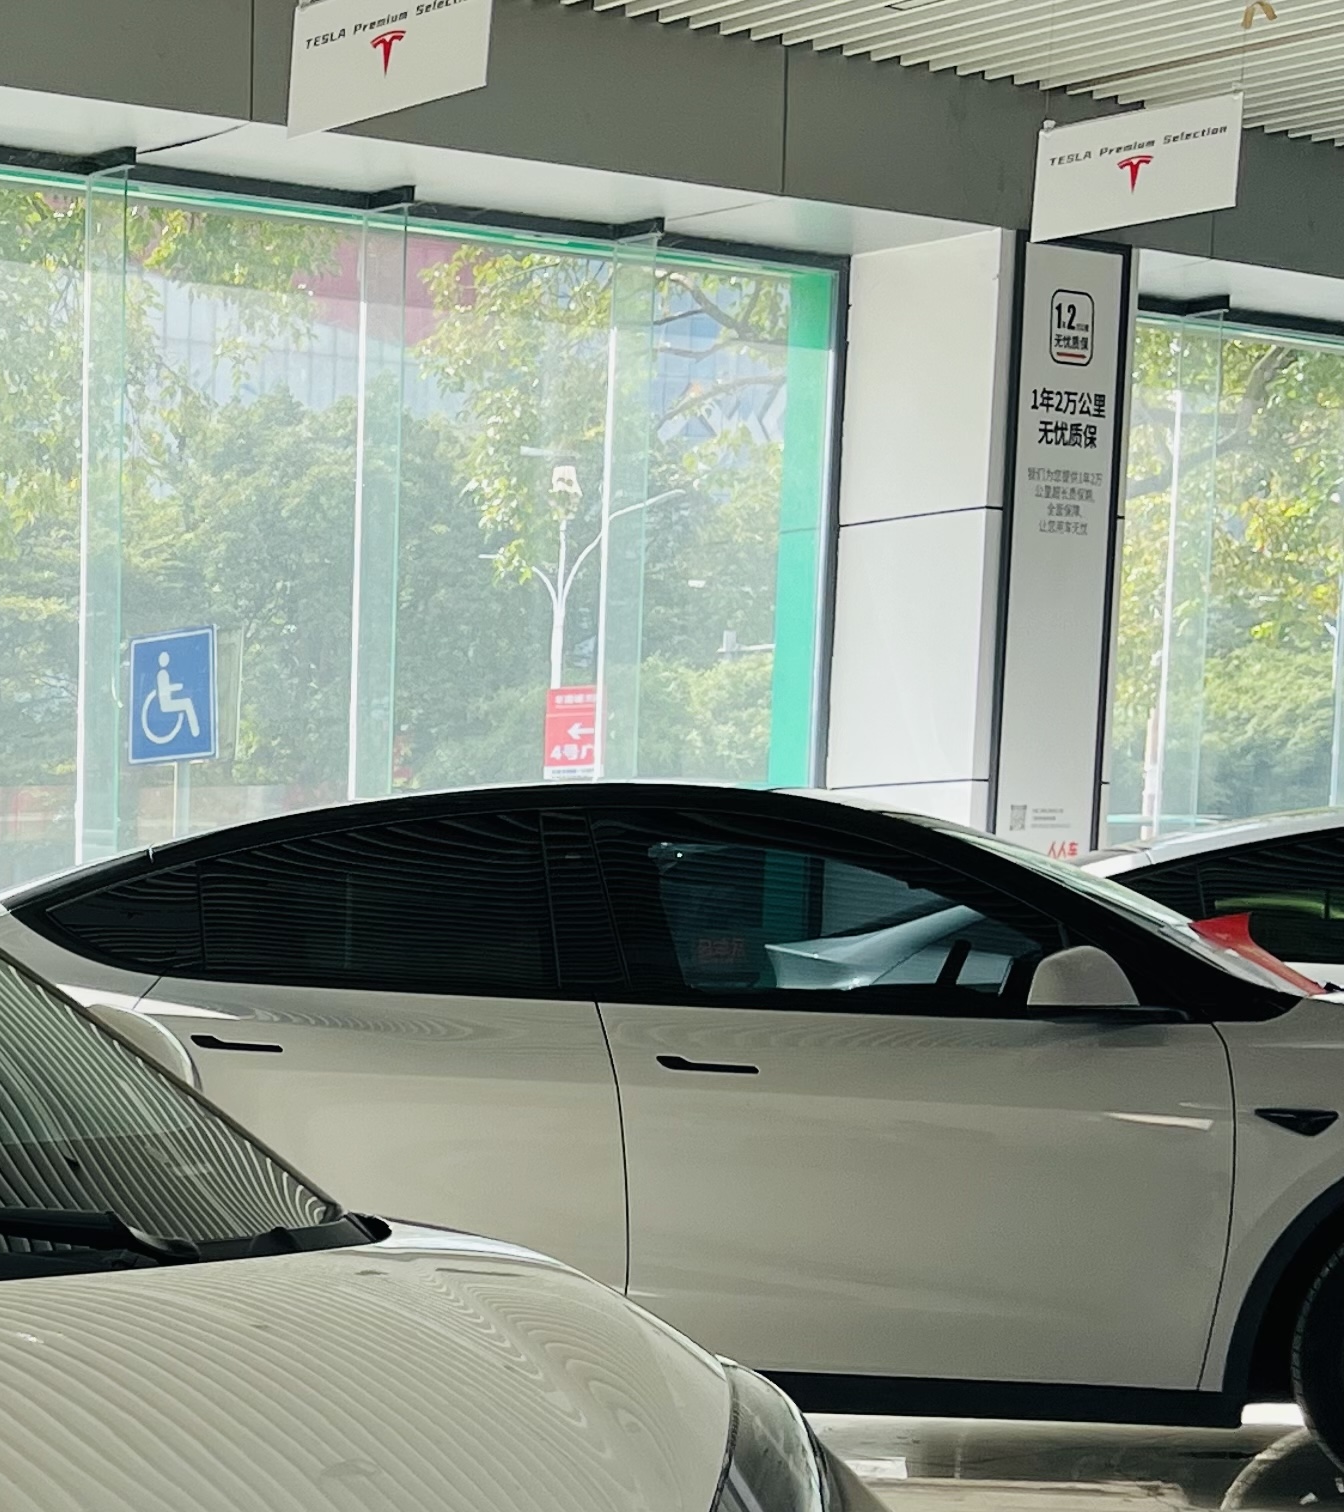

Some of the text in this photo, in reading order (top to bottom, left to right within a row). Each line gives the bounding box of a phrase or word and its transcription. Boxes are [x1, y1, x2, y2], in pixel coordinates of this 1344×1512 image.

[305, 27, 346, 50] TESLA
[353, 11, 409, 35] Premium
[1049, 125, 1227, 166] TESLA Premium Selection
[1030, 387, 1107, 419] 1年2万公里
[1037, 420, 1098, 450] 无忧质保
